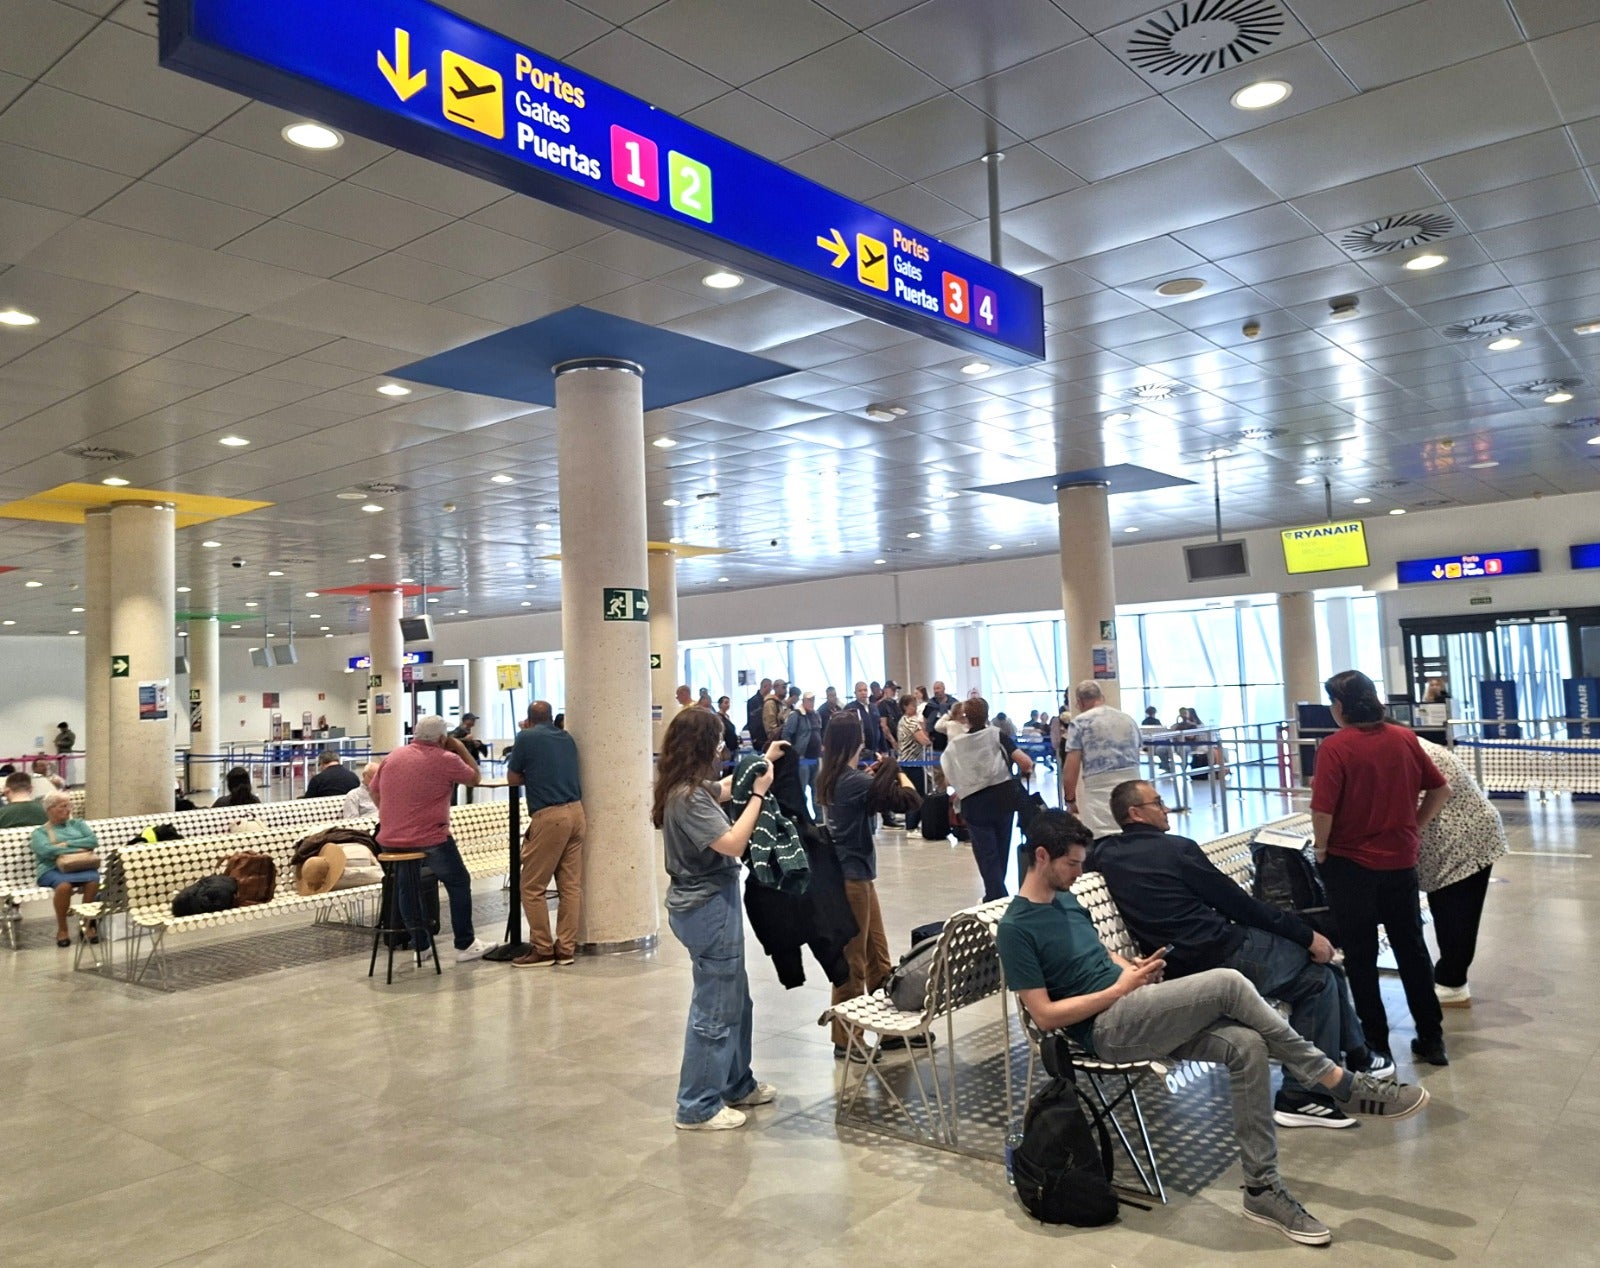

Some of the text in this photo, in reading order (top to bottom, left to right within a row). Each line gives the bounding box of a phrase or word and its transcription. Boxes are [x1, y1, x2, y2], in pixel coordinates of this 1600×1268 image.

[515, 52, 586, 109] Portes
[515, 91, 571, 134] Gates
[516, 122, 602, 180] Puertas
[624, 140, 703, 210] 1 2
[893, 228, 930, 262] Portes
[893, 254, 923, 282] Gates
[894, 277, 939, 312] Puertas
[949, 281, 994, 326] 3 4
[1294, 524, 1359, 539] RYANAIR
